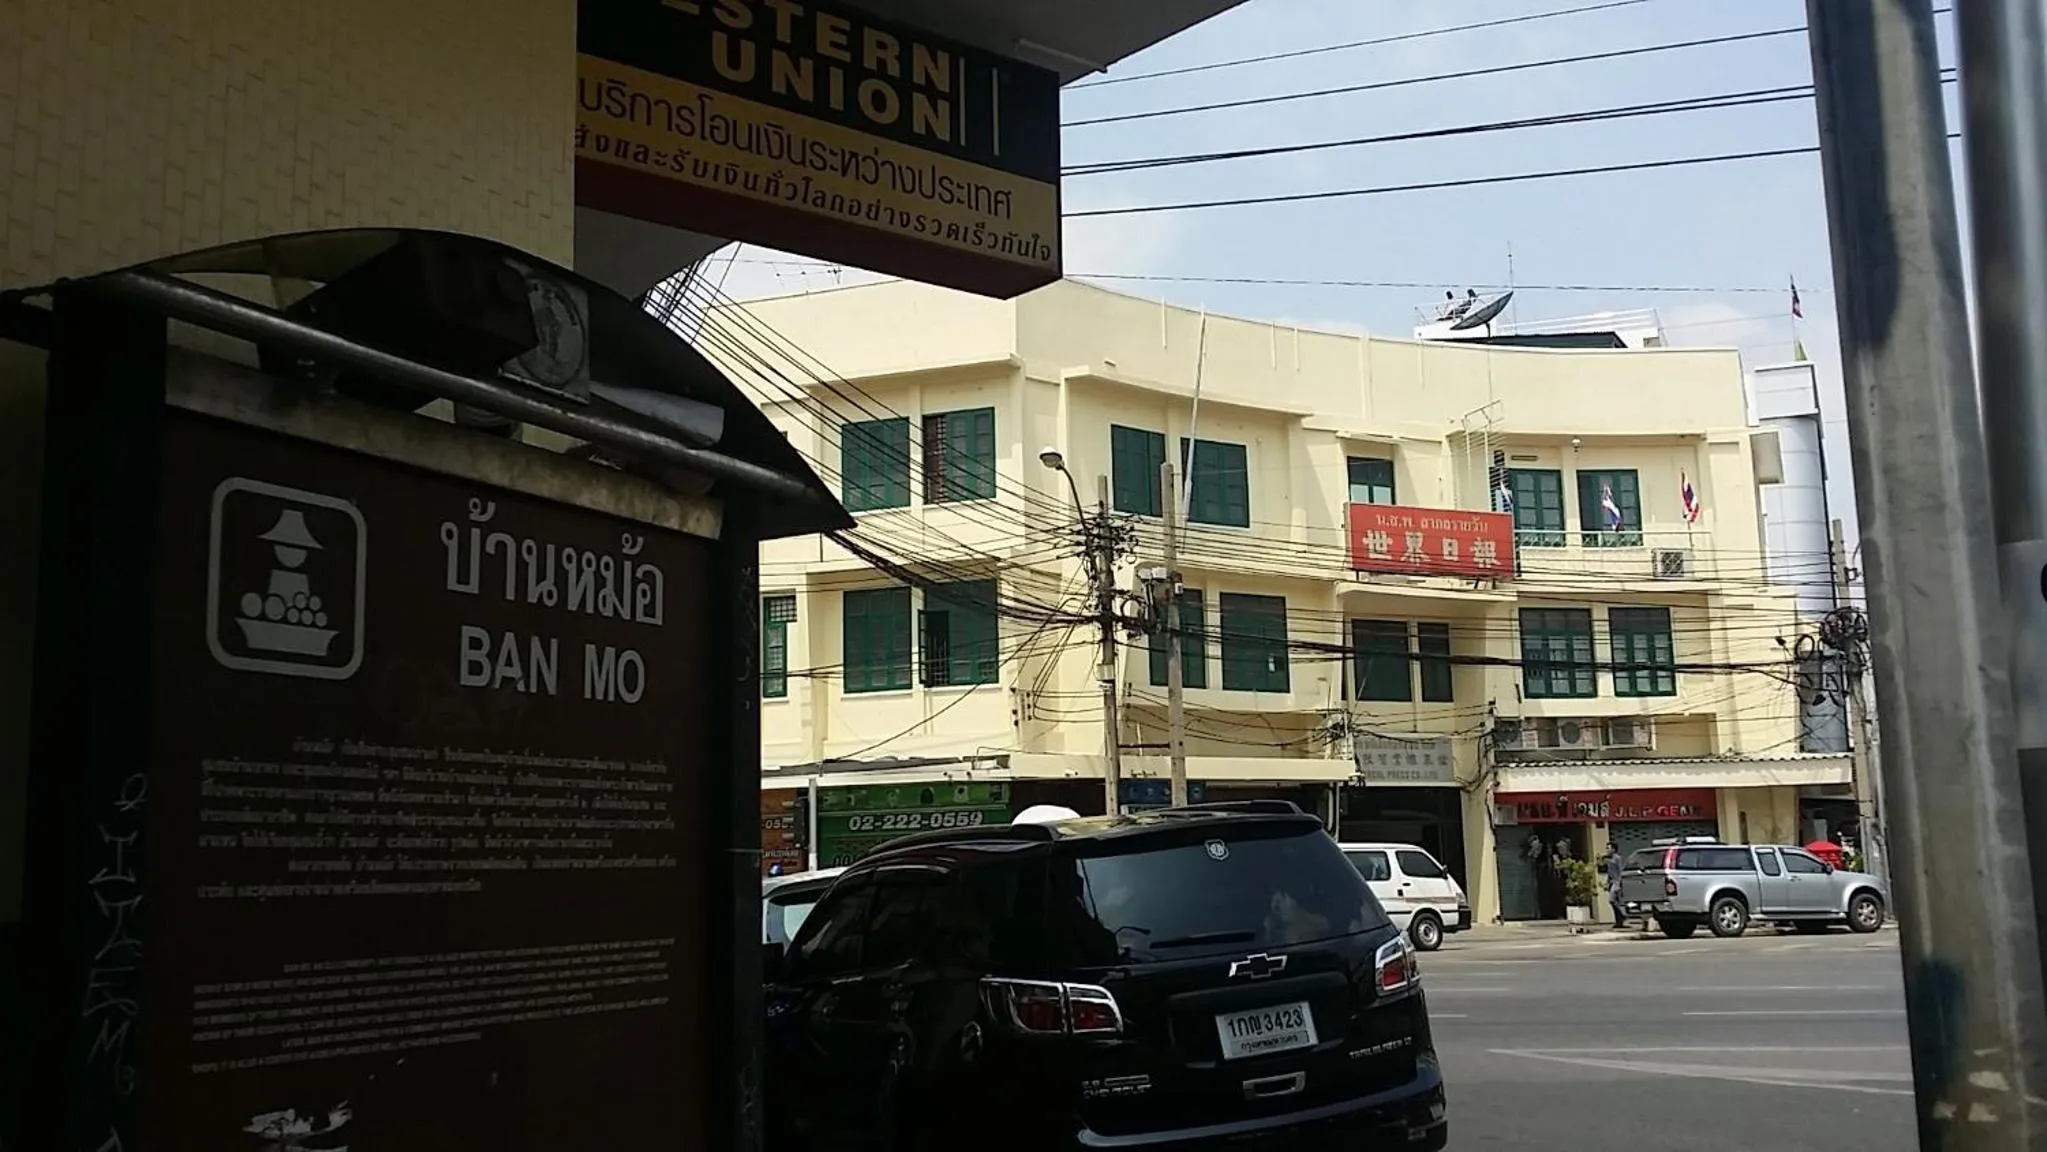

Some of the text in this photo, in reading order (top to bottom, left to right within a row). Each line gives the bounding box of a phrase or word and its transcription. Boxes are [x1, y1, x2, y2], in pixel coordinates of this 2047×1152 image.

[711, 30, 951, 142] UNION
[579, 77, 1012, 219] บริการโอนเงินระหว่างประเทศ
[440, 497, 665, 626] บ้านหม้อ
[459, 625, 646, 704] BAN MO
[849, 810, 984, 832] 02-222-0559
[1263, 1008, 1303, 1031] 3423
